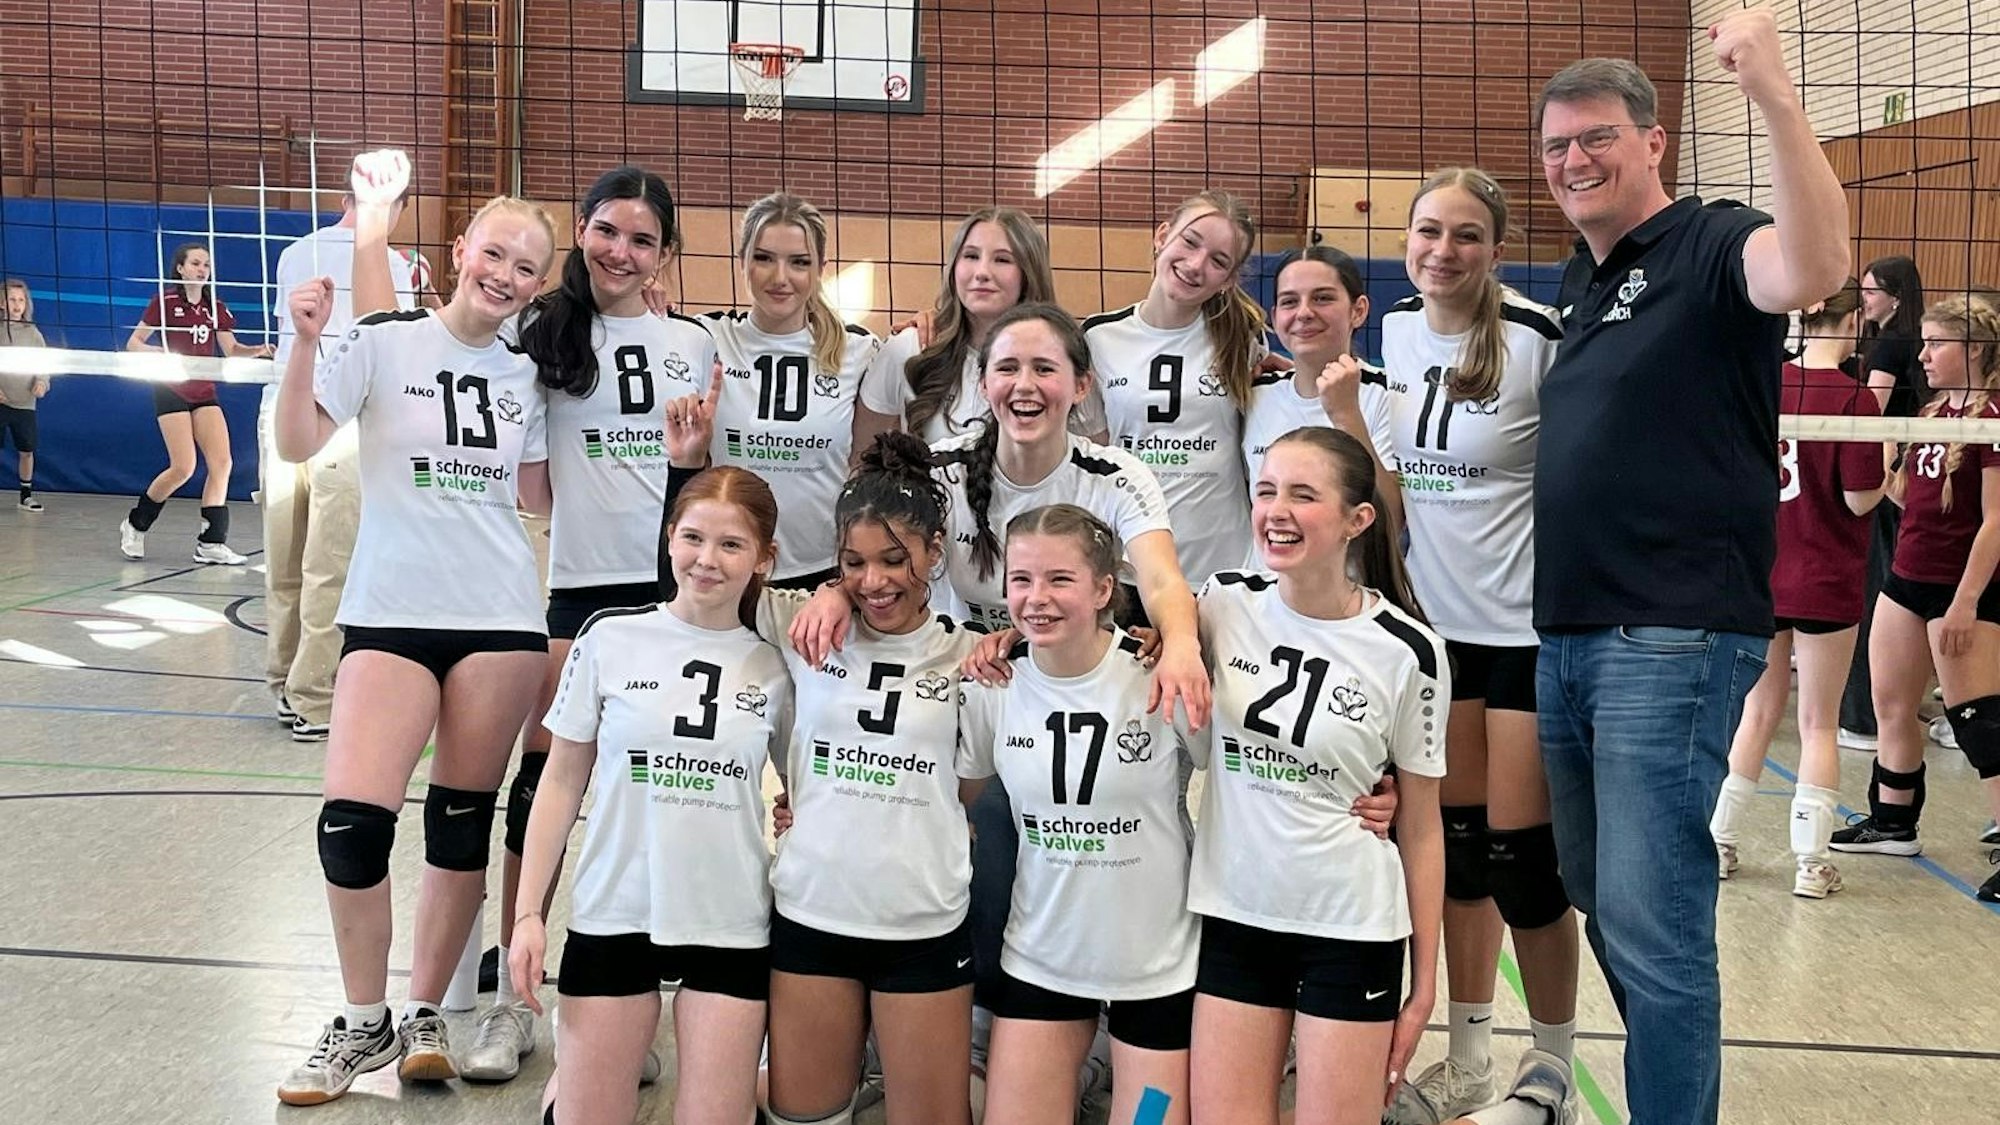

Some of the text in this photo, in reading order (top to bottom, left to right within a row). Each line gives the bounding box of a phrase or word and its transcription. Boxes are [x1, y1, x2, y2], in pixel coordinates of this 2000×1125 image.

[190, 324, 209, 345] 19
[614, 345, 655, 415] 8
[724, 367, 751, 379] JAKO
[403, 385, 435, 398] JAKO
[754, 355, 808, 421] 10
[1148, 354, 1183, 422] 9
[436, 370, 497, 449] 13
[1416, 366, 1459, 450] 11
[607, 427, 664, 443] schroe
[747, 432, 832, 449] schroeder
[1137, 434, 1217, 451] schroeder
[608, 443, 661, 457] valves
[747, 446, 800, 461] valves
[1138, 450, 1188, 465] valves
[1404, 458, 1488, 478] schroeder
[1916, 443, 1945, 479] 13
[437, 475, 486, 492] valves
[1404, 475, 1455, 491] valves
[821, 663, 847, 679] AKO
[1228, 656, 1260, 675] JAKO
[625, 681, 659, 691] JAKO
[673, 659, 722, 740] 3
[857, 661, 905, 736] 5
[1243, 645, 1330, 748] 21
[1006, 735, 1034, 749] JAKO
[836, 745, 936, 775] schroeder
[1045, 711, 1108, 805] 17
[1243, 743, 1339, 781] schroder
[652, 771, 715, 791] valves
[834, 764, 896, 786] valves
[1246, 762, 1308, 783] valves
[1042, 816, 1142, 835] schroeder
[1043, 834, 1105, 852] valves
